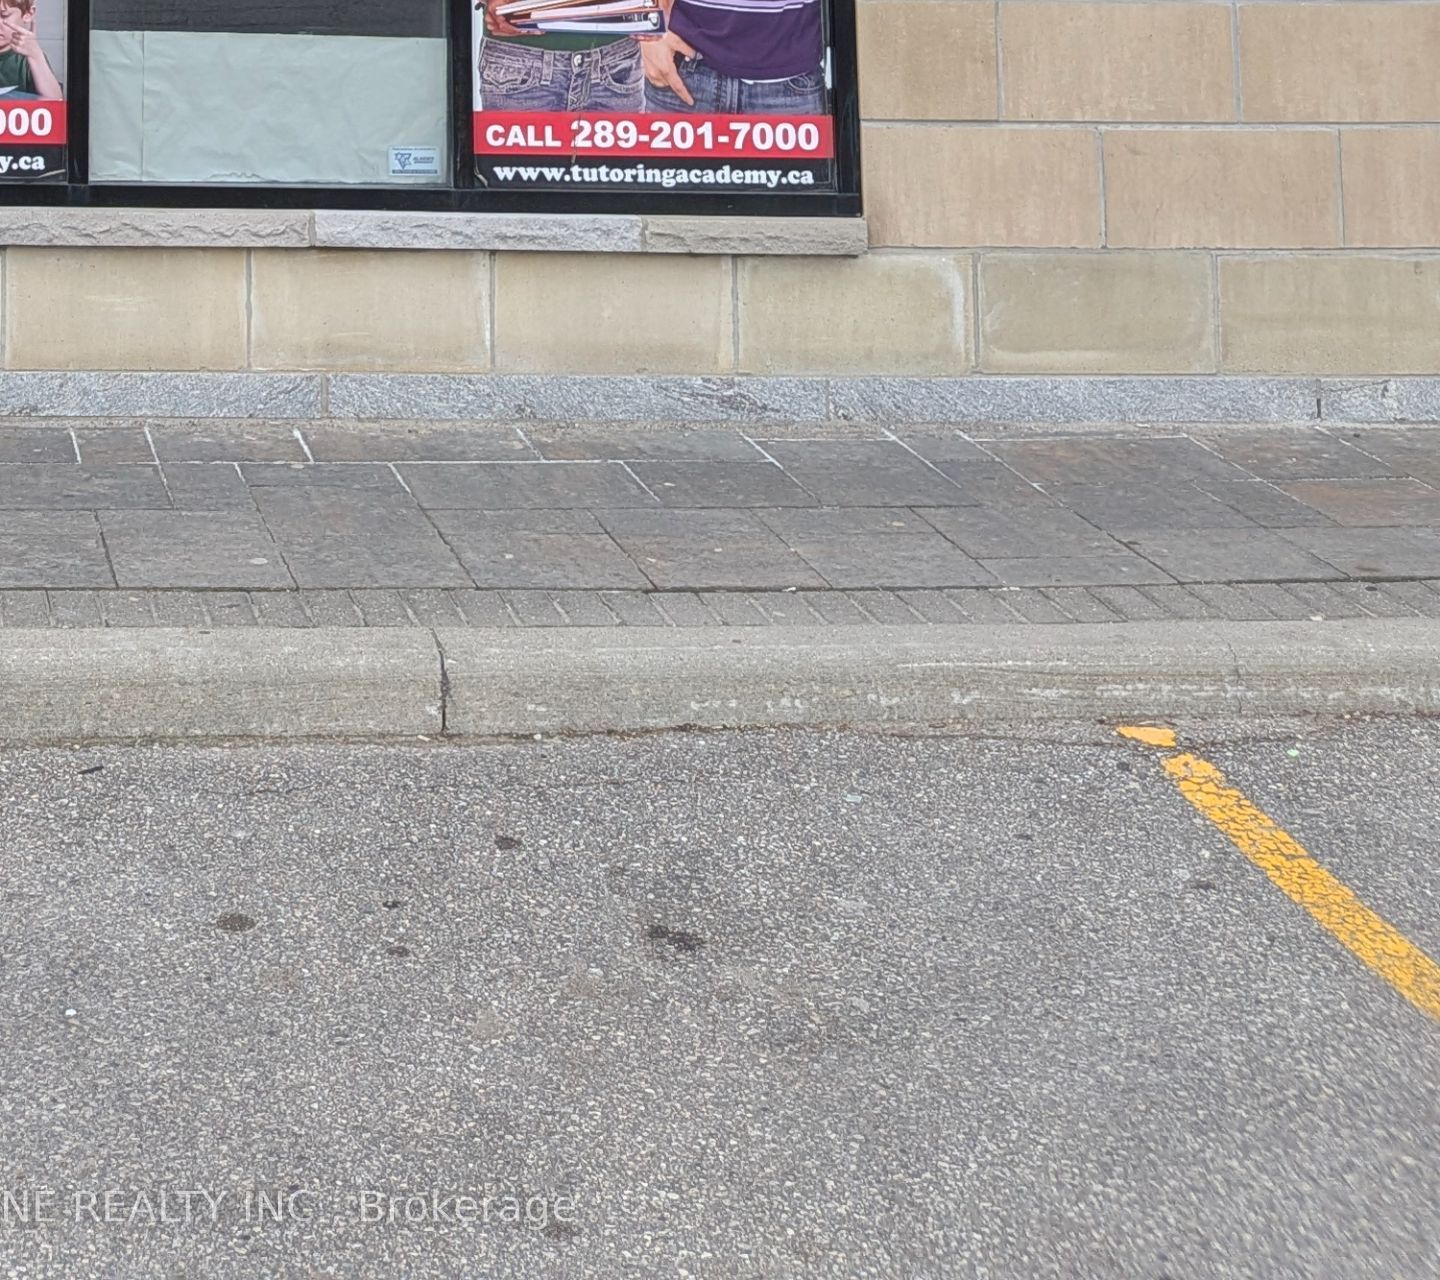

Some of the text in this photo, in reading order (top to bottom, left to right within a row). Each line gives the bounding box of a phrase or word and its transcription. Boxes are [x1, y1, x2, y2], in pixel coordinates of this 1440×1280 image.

[485, 120, 820, 151] CALL 289-201-7000
[493, 164, 815, 189] www.tutoringacademy.ca
